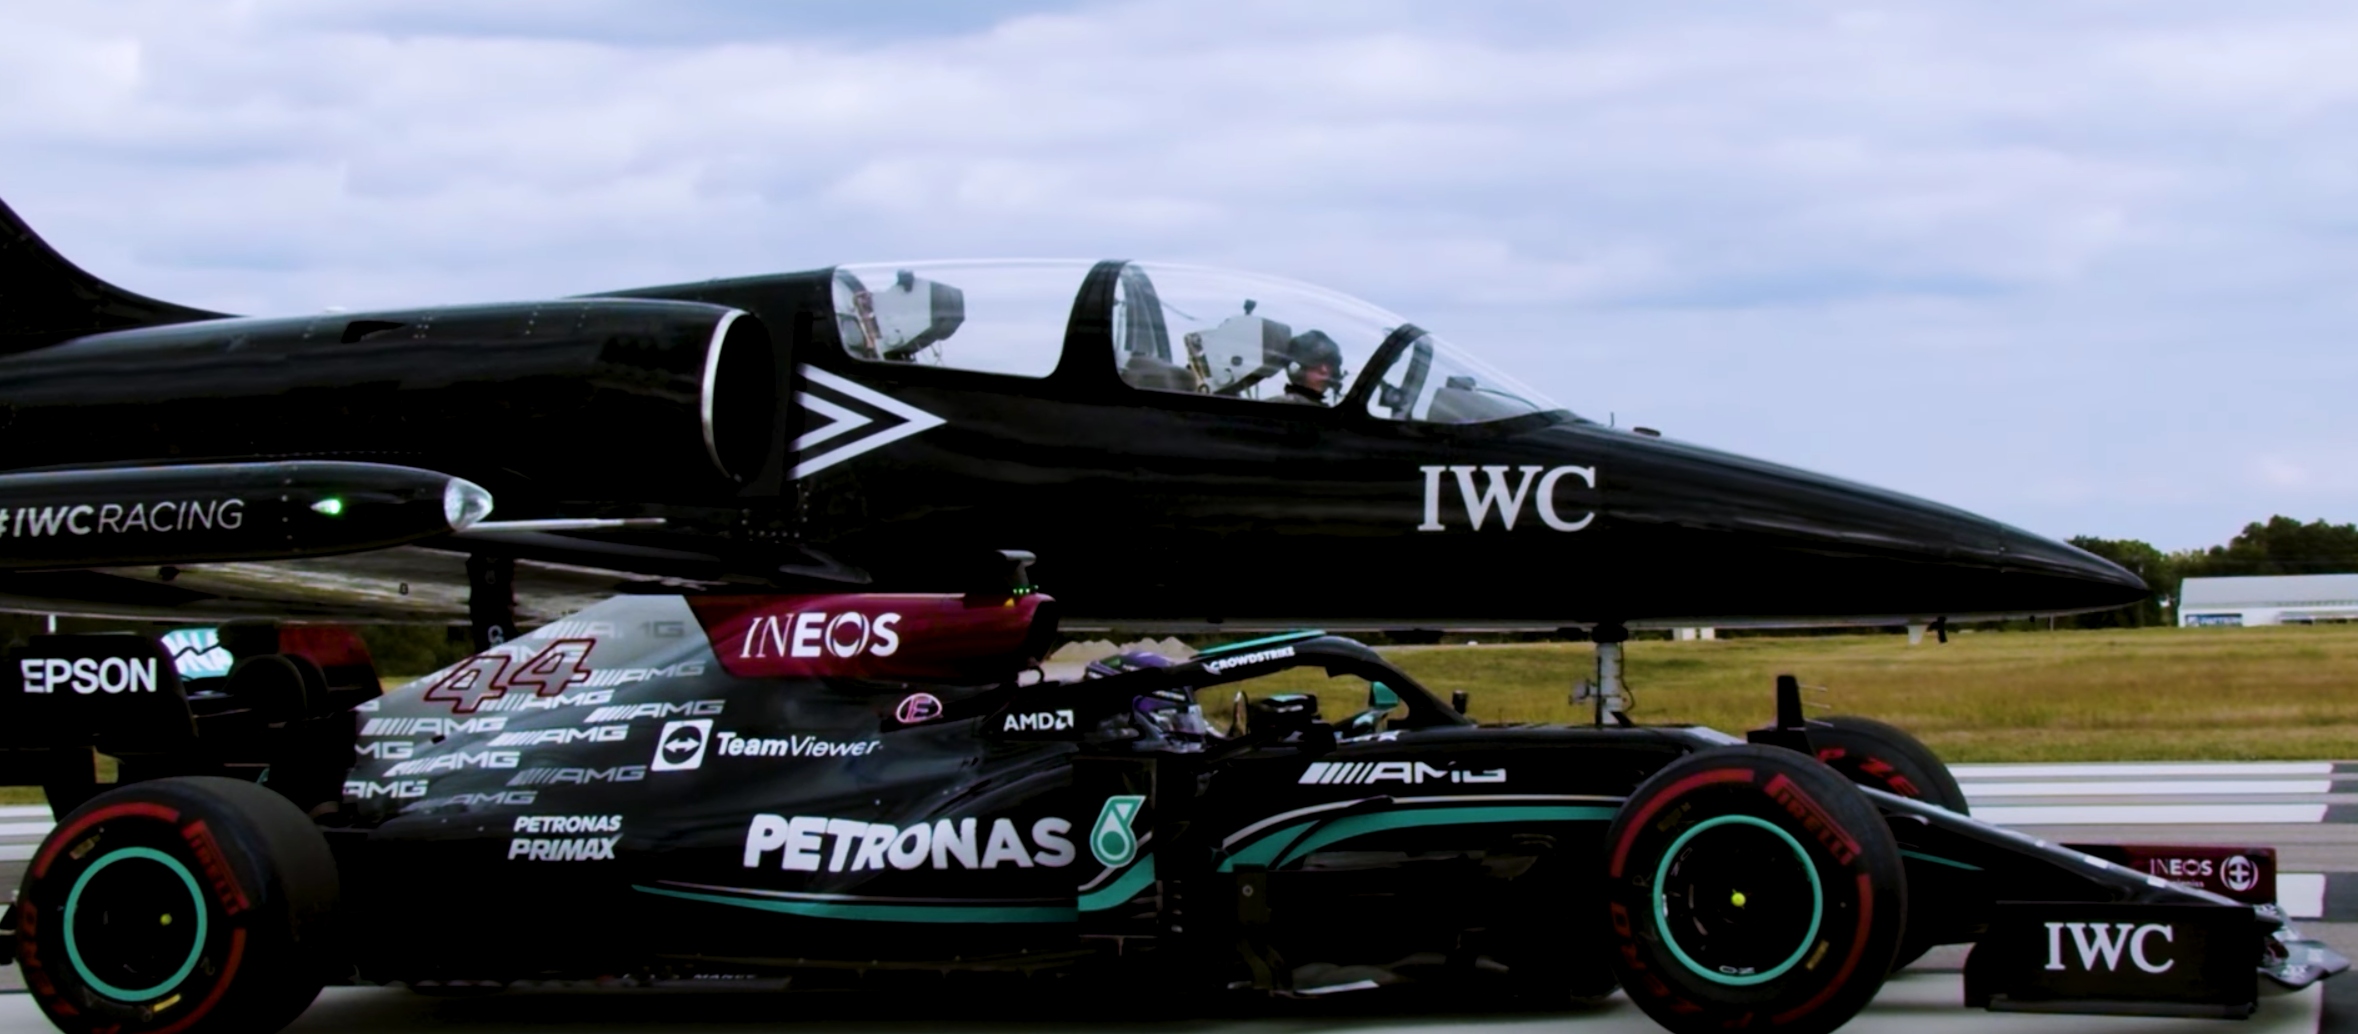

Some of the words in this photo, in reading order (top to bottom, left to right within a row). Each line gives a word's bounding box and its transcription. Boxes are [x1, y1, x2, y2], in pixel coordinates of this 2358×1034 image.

[1418, 465, 1596, 532] IWC
[739, 611, 901, 659] INEOS
[1210, 646, 1296, 671] CROWDSTRIKE
[21, 656, 157, 694] EPSON
[423, 638, 597, 714] 44
[616, 661, 706, 685] AMG
[517, 689, 616, 712] AMG
[627, 699, 726, 720] AMG
[407, 716, 509, 736] AMG
[1003, 711, 1055, 732] AMD
[532, 724, 630, 745] AMG
[715, 731, 881, 758] TeamViewer
[426, 751, 521, 772] AMG
[548, 765, 648, 785] AMG
[342, 779, 429, 799] AMG
[513, 814, 624, 833] PETRONAS
[1762, 772, 1863, 868] PIRELLI
[507, 833, 624, 862] PRIMAX
[743, 813, 1077, 873] PETRONAS
[2149, 857, 2214, 877] INEOS
[2043, 921, 2175, 974] IWC
